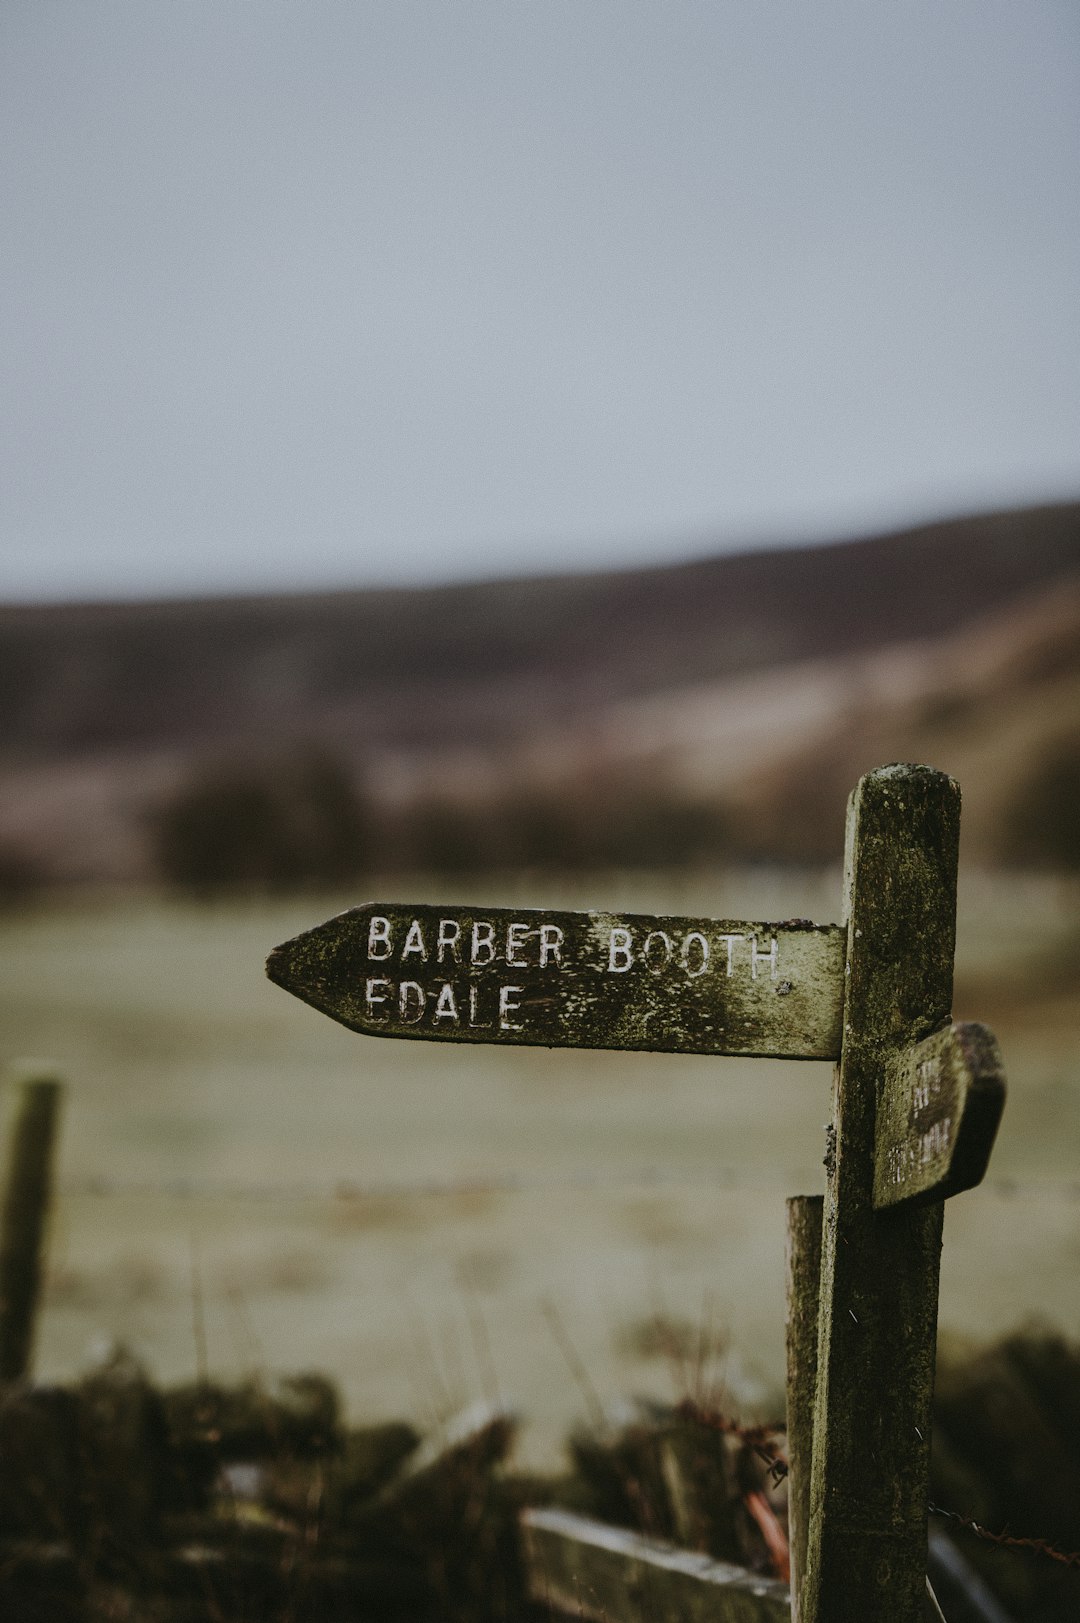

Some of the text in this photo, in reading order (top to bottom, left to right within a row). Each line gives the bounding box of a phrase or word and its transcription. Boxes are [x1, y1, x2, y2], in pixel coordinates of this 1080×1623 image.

[367, 916, 779, 980] BARBER BOOTH
[365, 977, 525, 1031] EDALE
